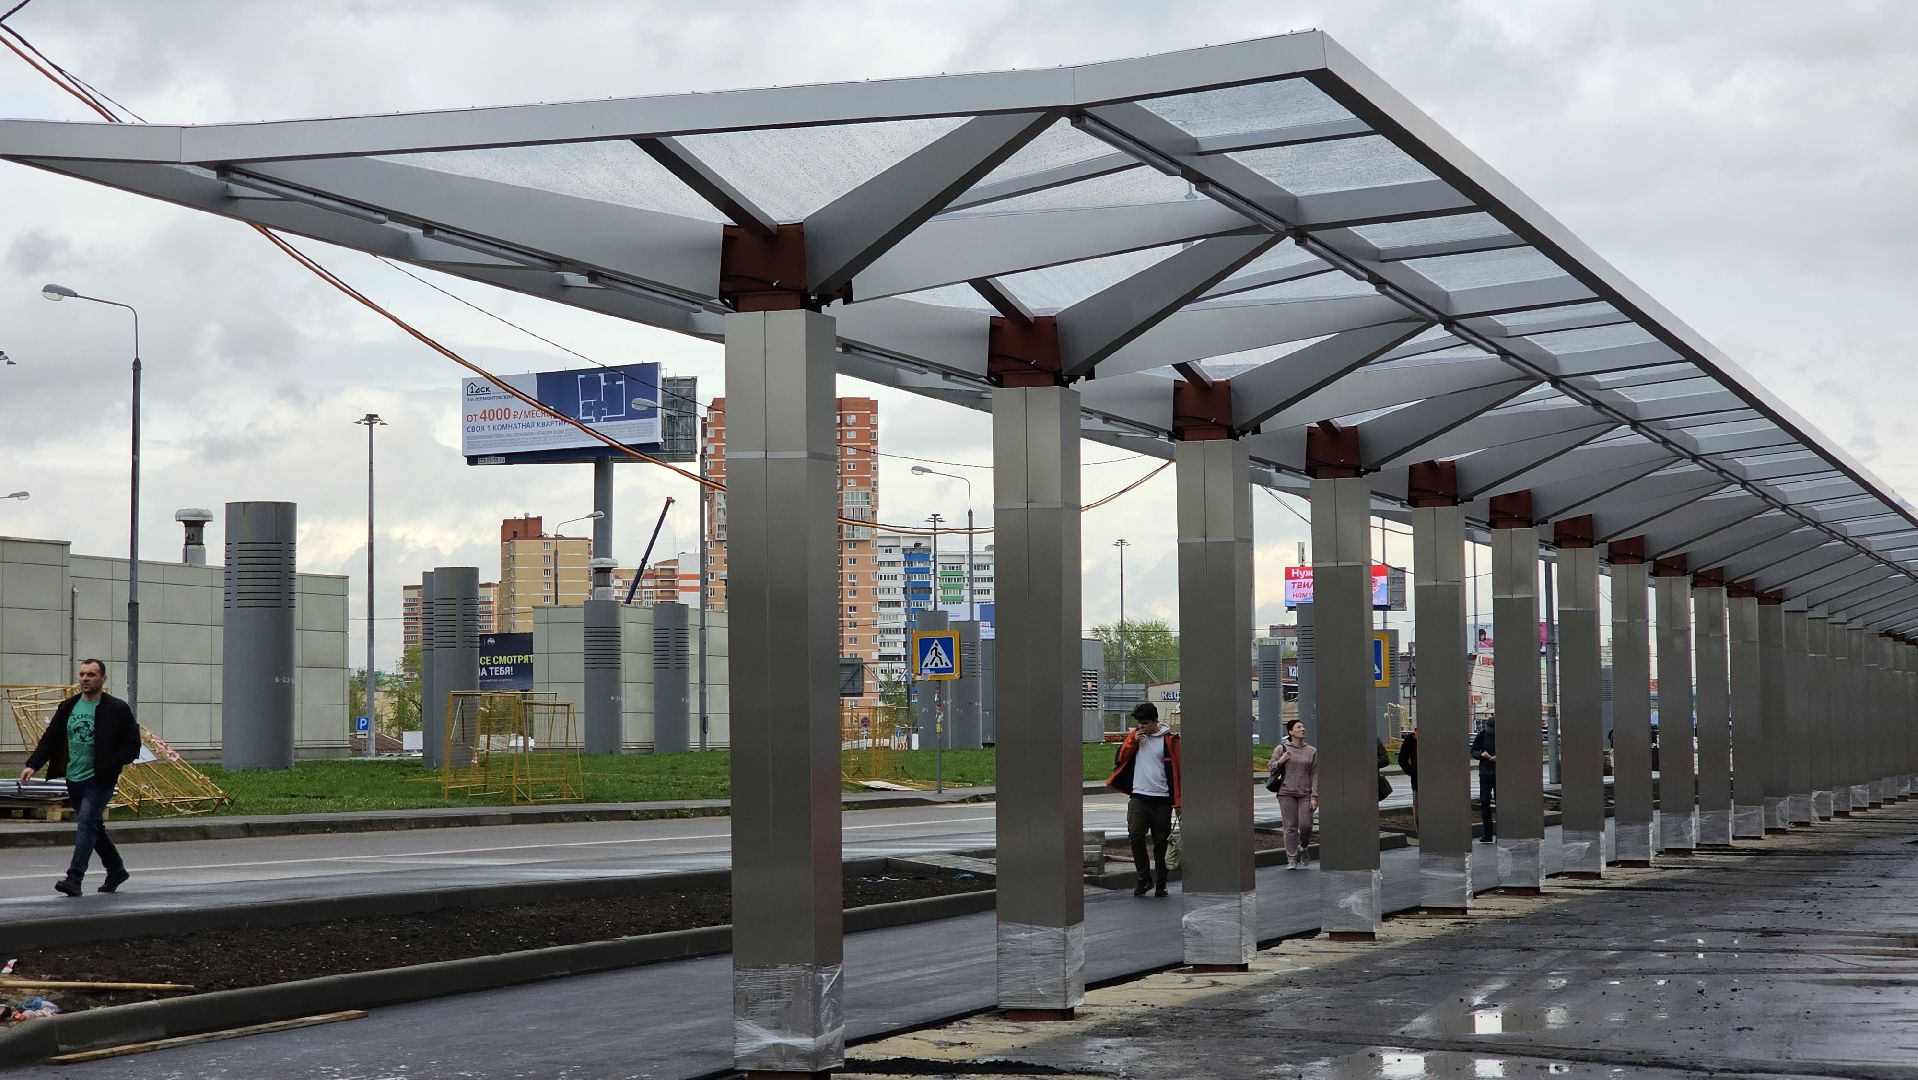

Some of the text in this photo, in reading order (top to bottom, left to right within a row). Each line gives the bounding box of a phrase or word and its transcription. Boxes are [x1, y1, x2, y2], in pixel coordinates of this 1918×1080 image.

[466, 414, 478, 423] ОТ
[480, 407, 511, 421] 4000
[487, 421, 535, 431] 1-КОМНАТНАЯ
[493, 654, 534, 665] СМОТРЯТ
[489, 666, 514, 676] ТЕБЯ!
[359, 718, 367, 730] P
